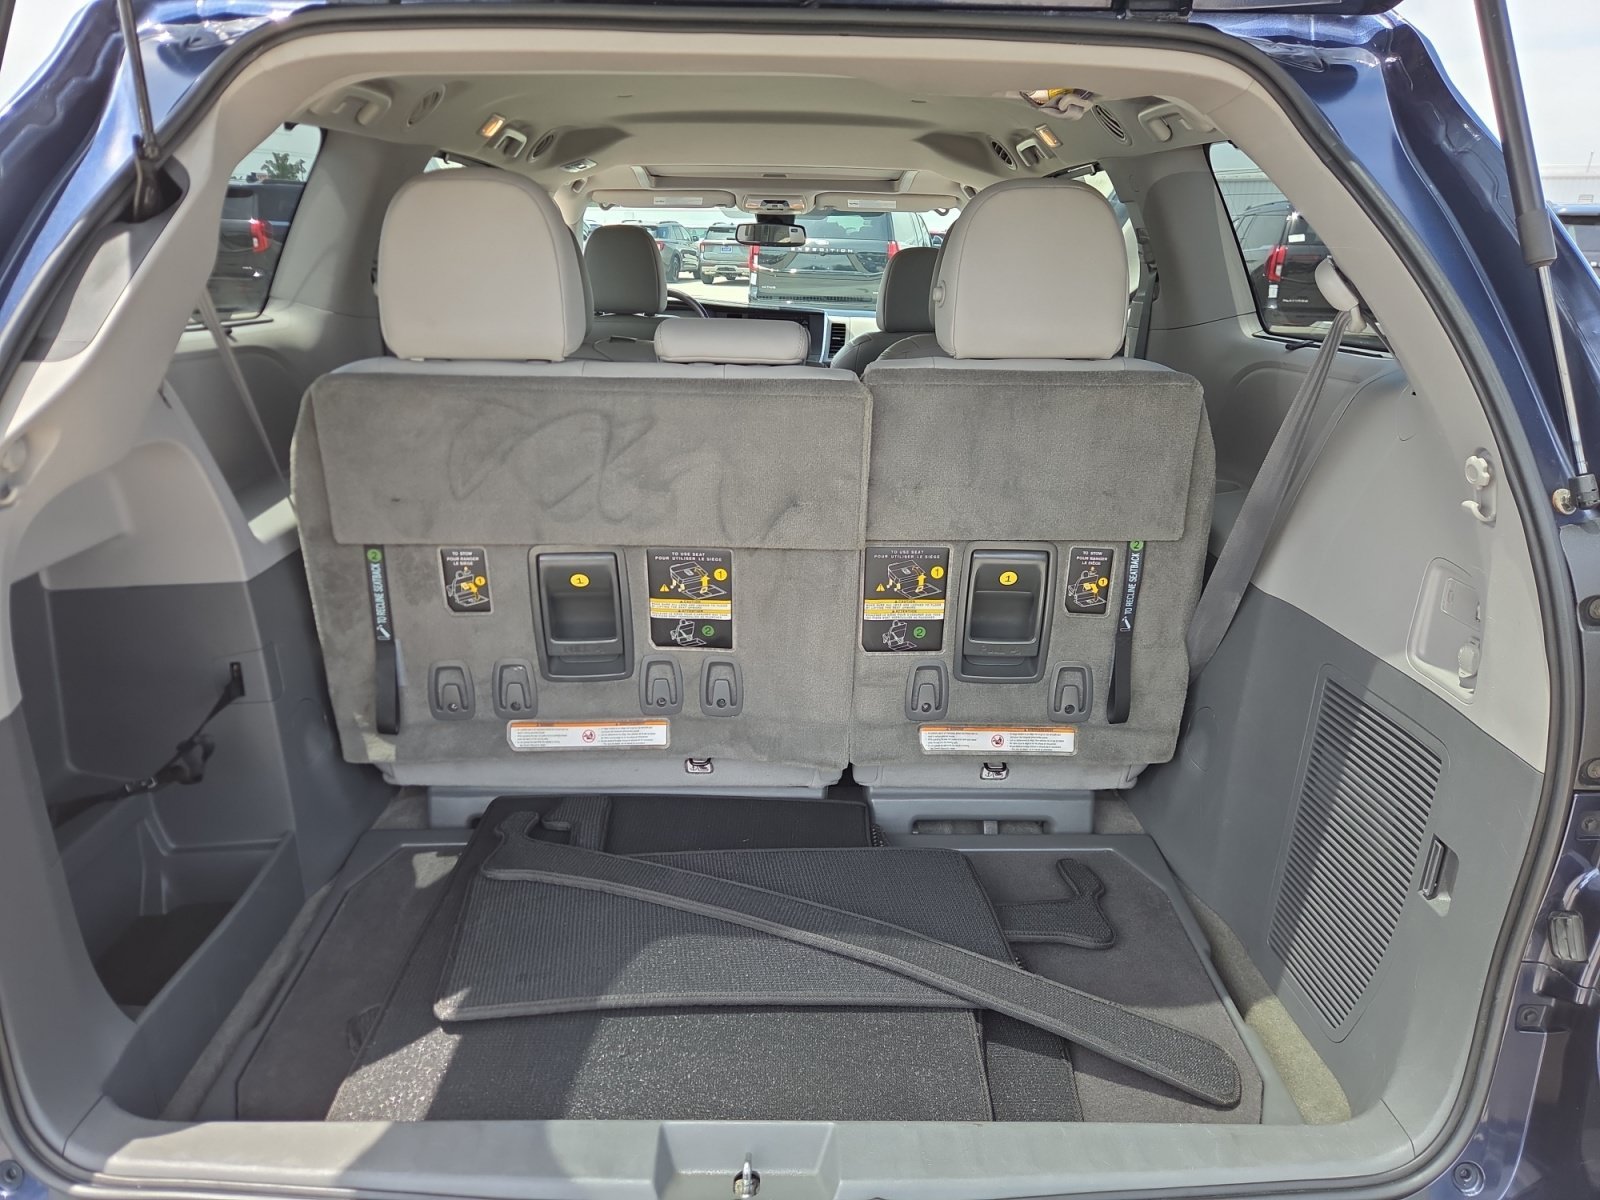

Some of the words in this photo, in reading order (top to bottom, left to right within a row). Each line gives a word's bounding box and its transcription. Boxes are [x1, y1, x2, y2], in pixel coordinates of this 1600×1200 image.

[1129, 553, 1140, 582] SEATBACK
[1125, 583, 1137, 607] RECLINE
[1124, 607, 1133, 615] TO
[377, 616, 387, 624] TO
